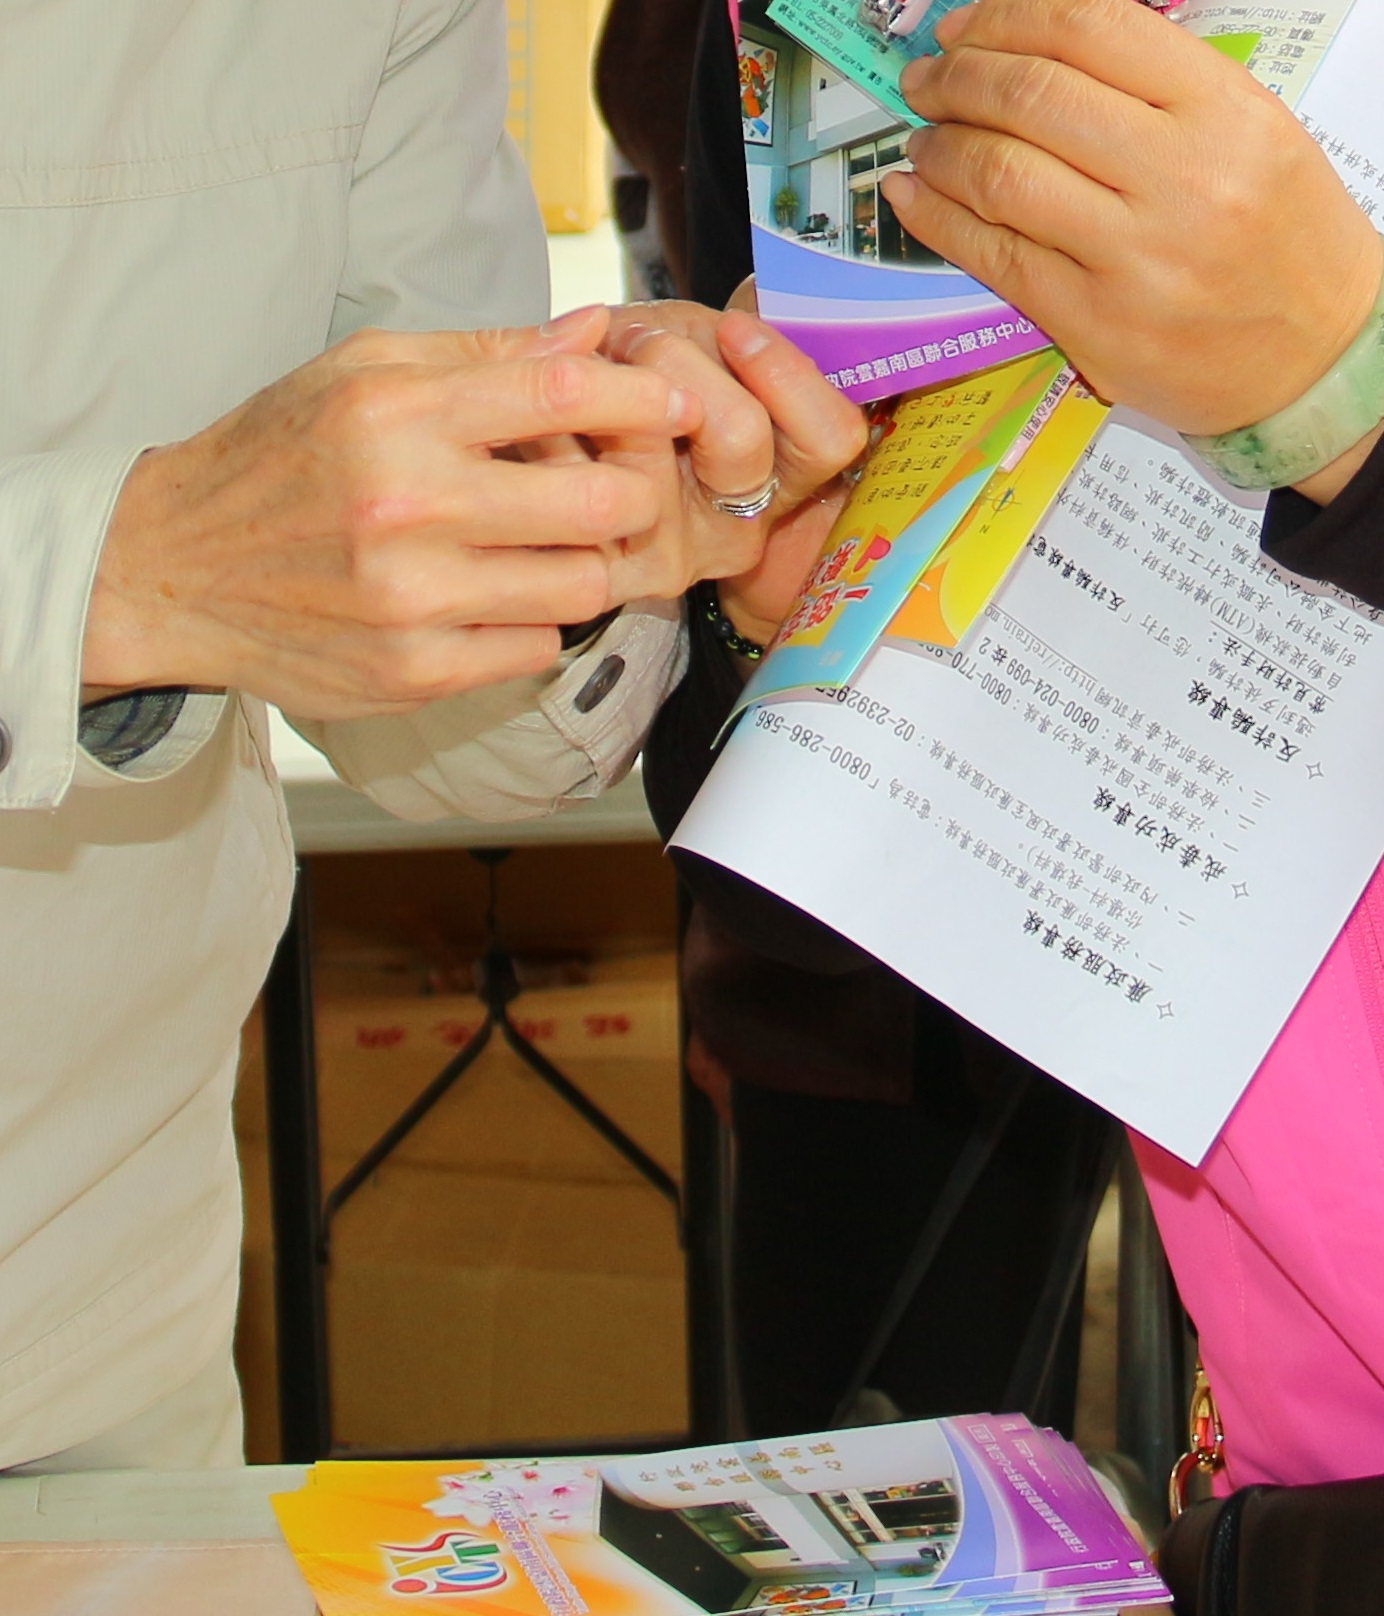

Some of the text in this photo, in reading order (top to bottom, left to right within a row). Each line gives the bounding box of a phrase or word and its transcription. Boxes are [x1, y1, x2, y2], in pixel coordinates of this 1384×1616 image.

[1181, 677, 1305, 767] 反詐騙專線
[1085, 782, 1230, 889] 戒毒成功專線
[1015, 905, 1156, 1008] 廉政服務專線
